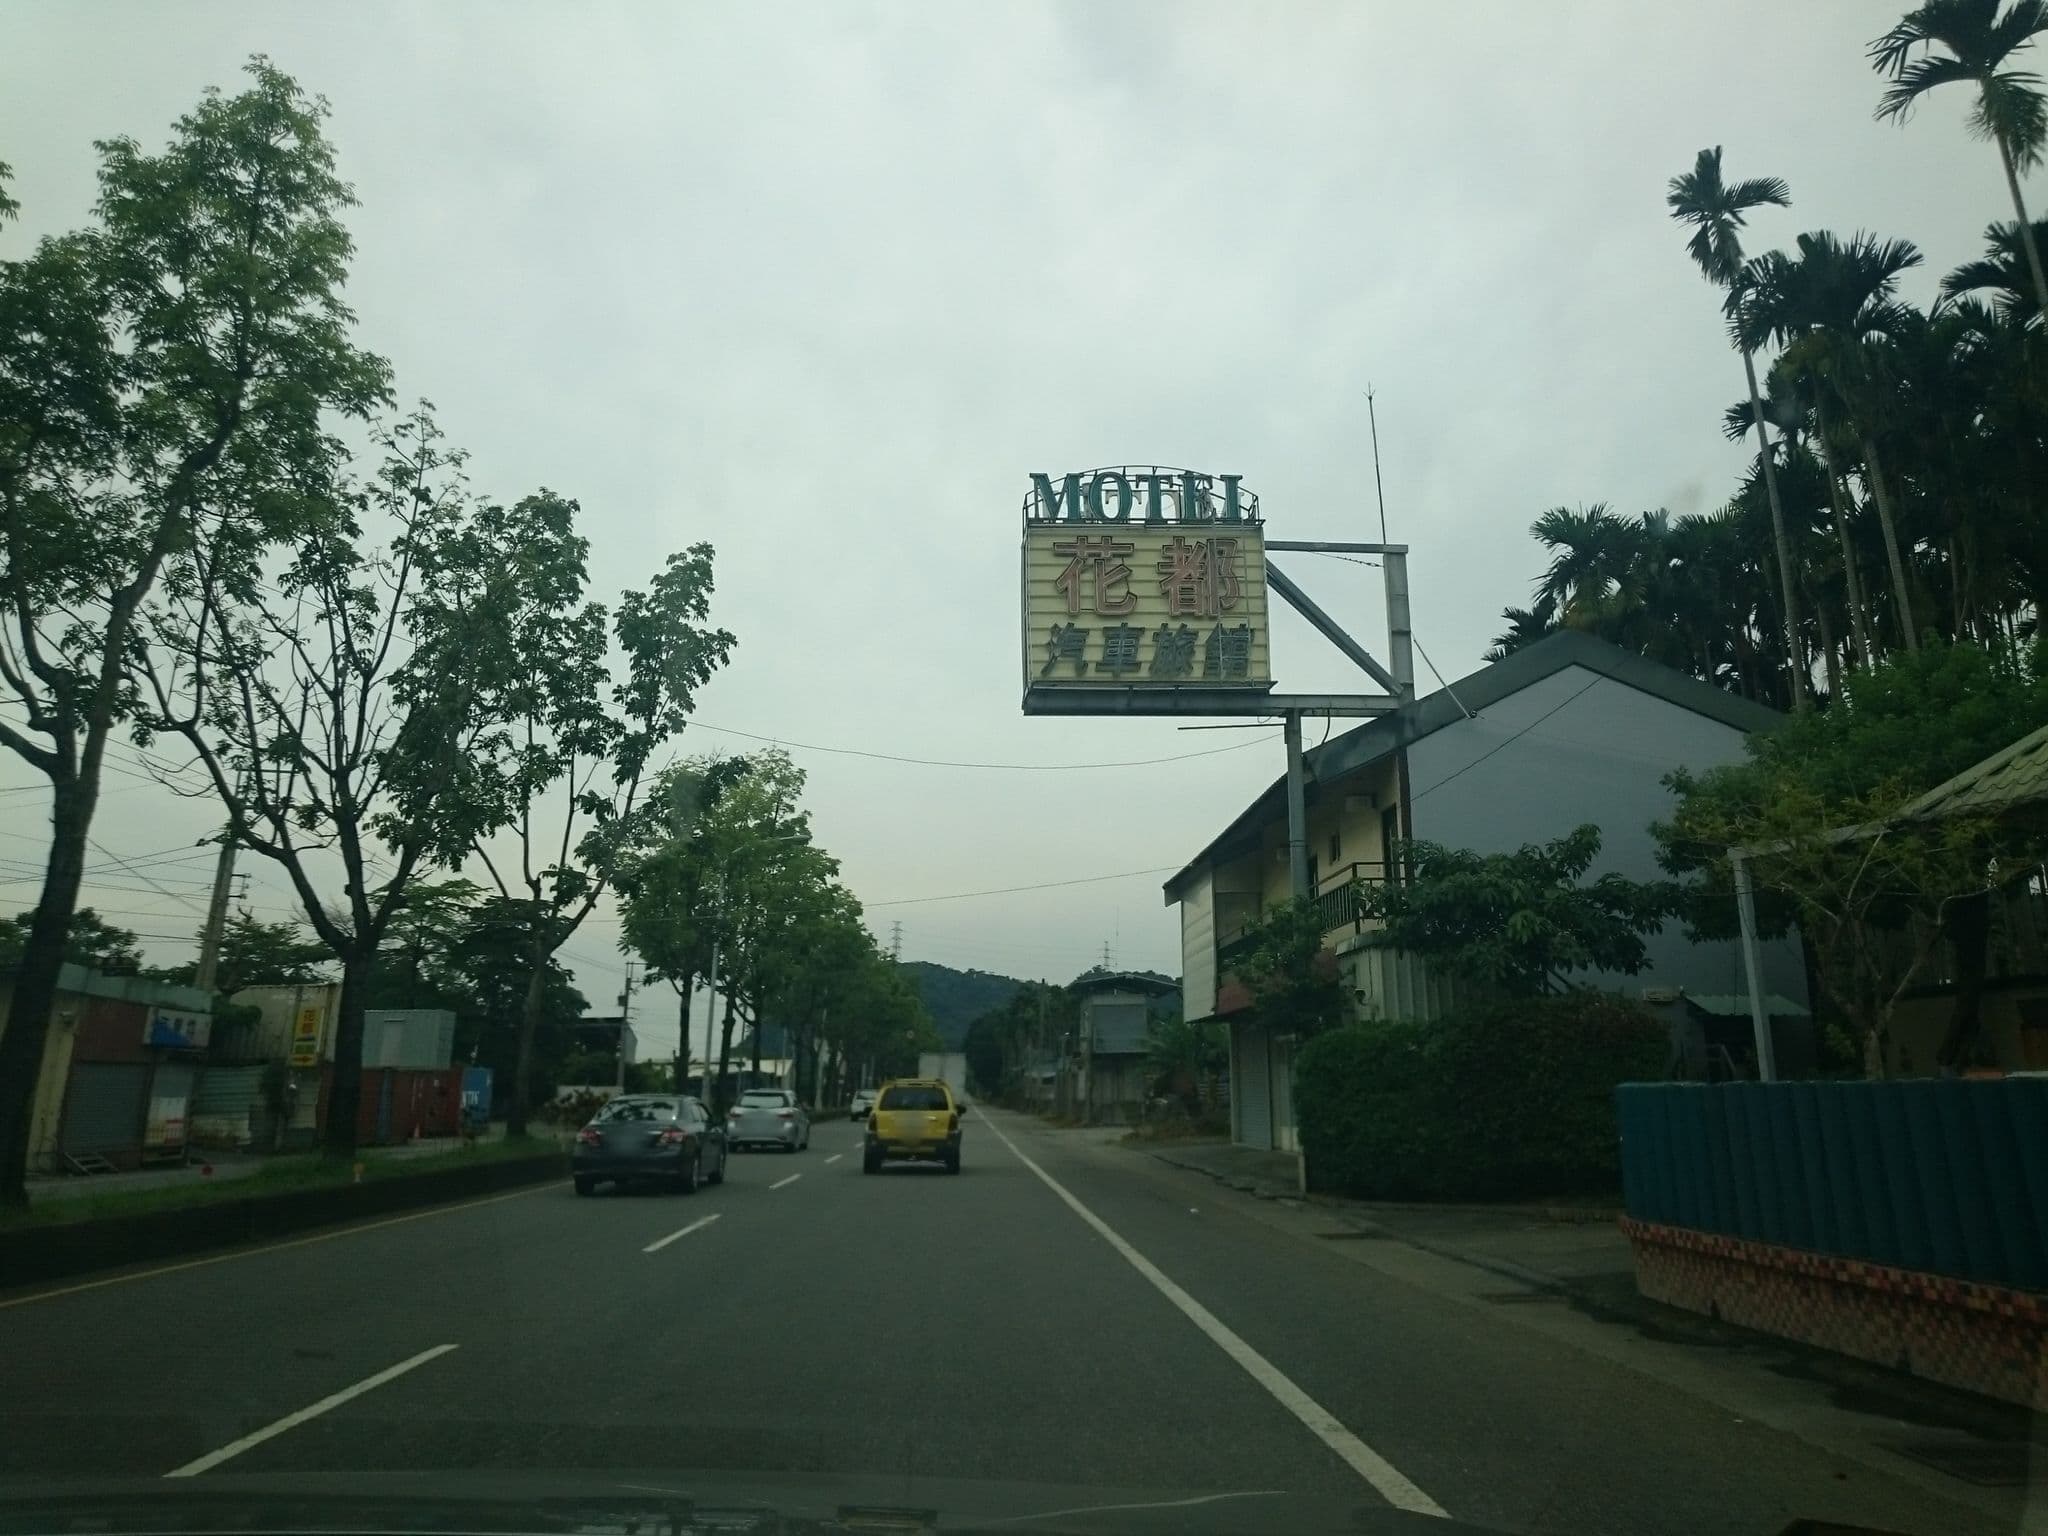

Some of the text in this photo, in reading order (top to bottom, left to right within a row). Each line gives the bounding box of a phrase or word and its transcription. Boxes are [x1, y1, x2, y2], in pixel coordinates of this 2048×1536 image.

[1029, 472, 1255, 526] MOTEL
[1053, 535, 1240, 618] 花都
[1041, 622, 1256, 678] 汽車旅館
